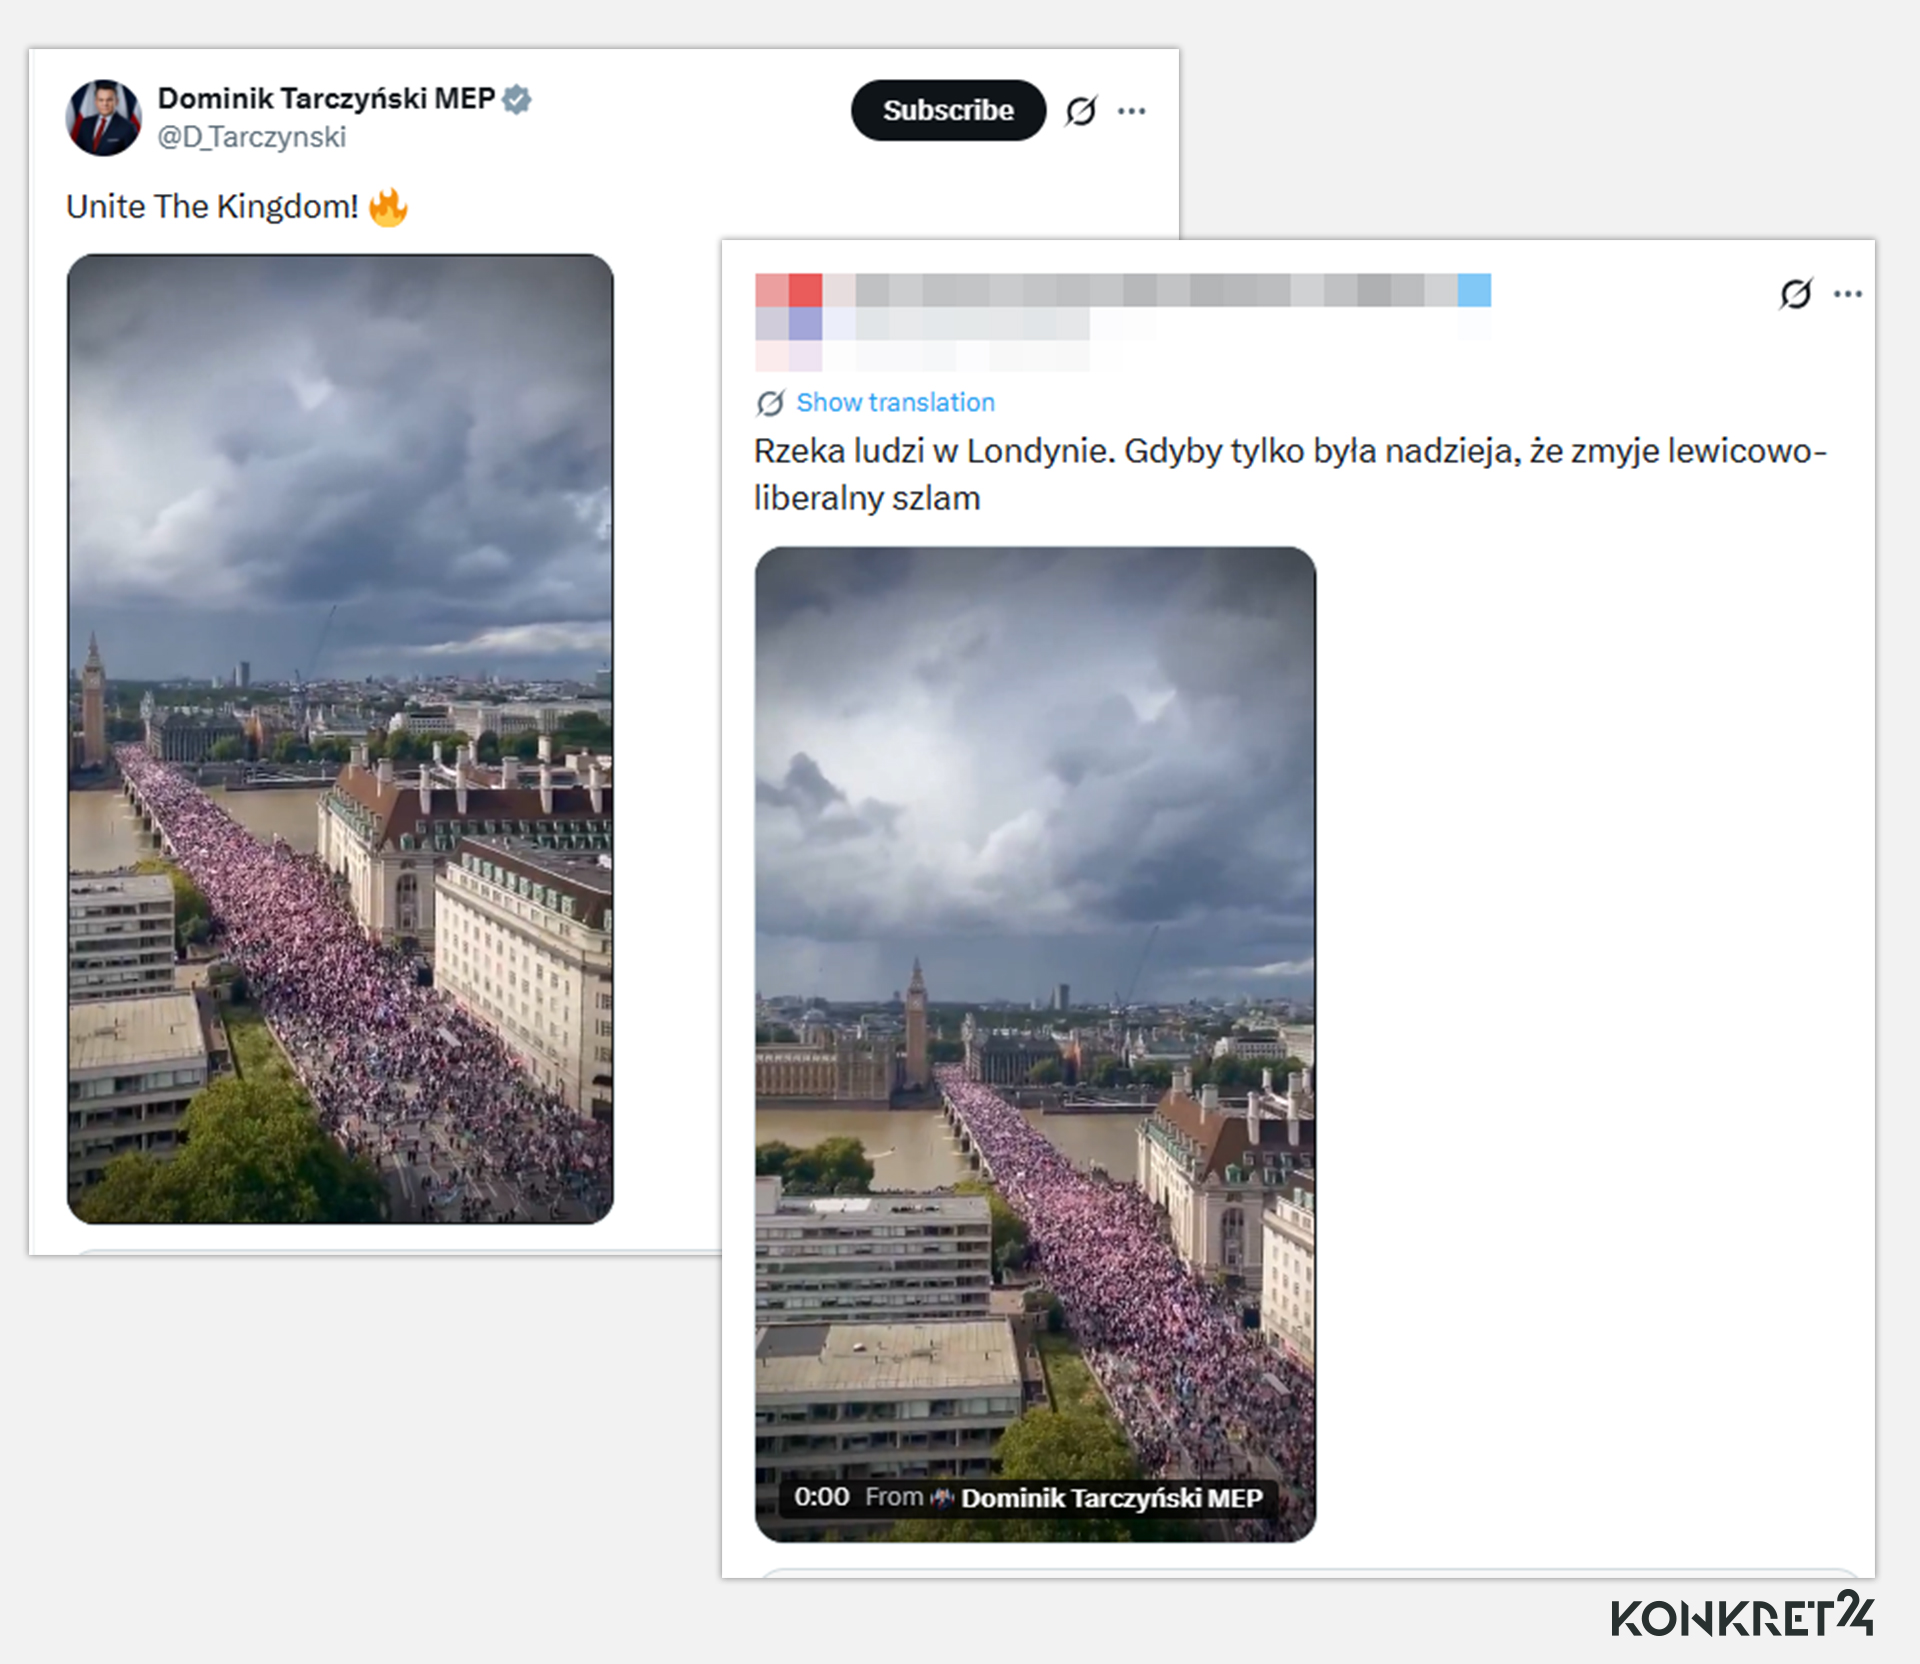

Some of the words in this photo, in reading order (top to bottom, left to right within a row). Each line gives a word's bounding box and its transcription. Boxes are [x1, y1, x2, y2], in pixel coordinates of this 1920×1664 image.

[158, 86, 274, 109] Dominik
[280, 86, 427, 116] Tarczyński
[436, 86, 496, 109] MEP
[883, 98, 1015, 121] Subscribe
[157, 124, 347, 154] @D_Tarczynski
[66, 192, 146, 219] Unite
[153, 192, 209, 219] The
[218, 192, 359, 225] Kingdom!
[797, 391, 863, 412] Show
[868, 391, 995, 412] translation
[755, 436, 846, 464] Rzeka
[855, 436, 925, 464] ludzi
[933, 443, 960, 464] w
[968, 436, 1116, 470] Londynie.
[1124, 436, 1224, 470] Gdyby
[1231, 436, 1305, 470] tylko
[1314, 436, 1377, 470] była
[1386, 436, 1522, 470] nadzieja,
[1530, 436, 1564, 464] że
[1572, 436, 1660, 470] zmyje
[1669, 436, 1828, 464] lewicowo-
[755, 483, 886, 517] liberalny
[892, 483, 981, 511] szlam
[794, 1486, 851, 1507] 0:00
[865, 1486, 924, 1507] From
[961, 1486, 1067, 1509] Dominik
[1071, 1486, 1203, 1515] Tarczyński
[1207, 1488, 1264, 1509] MEP
